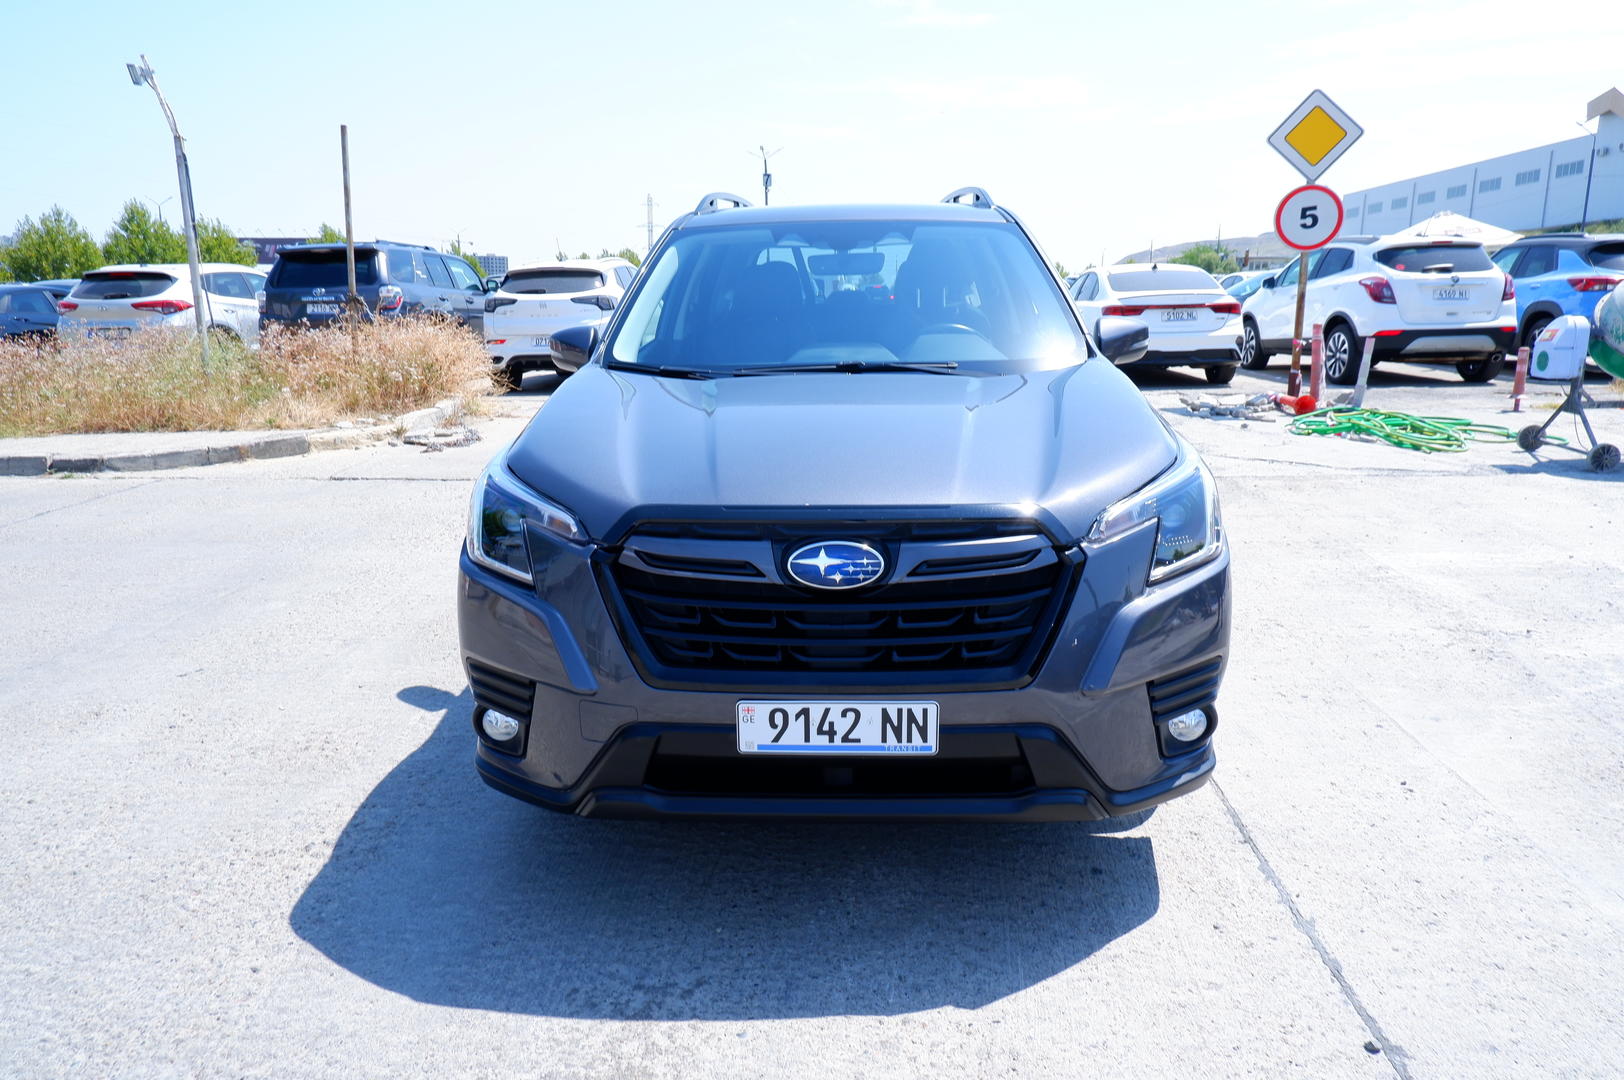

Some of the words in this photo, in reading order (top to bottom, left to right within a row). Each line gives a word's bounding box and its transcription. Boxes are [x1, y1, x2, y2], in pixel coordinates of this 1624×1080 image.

[1300, 205, 1319, 229] 5
[1166, 311, 1184, 320] 5102
[742, 715, 755, 724] GE
[768, 707, 862, 744] 9142
[880, 707, 929, 744] NN
